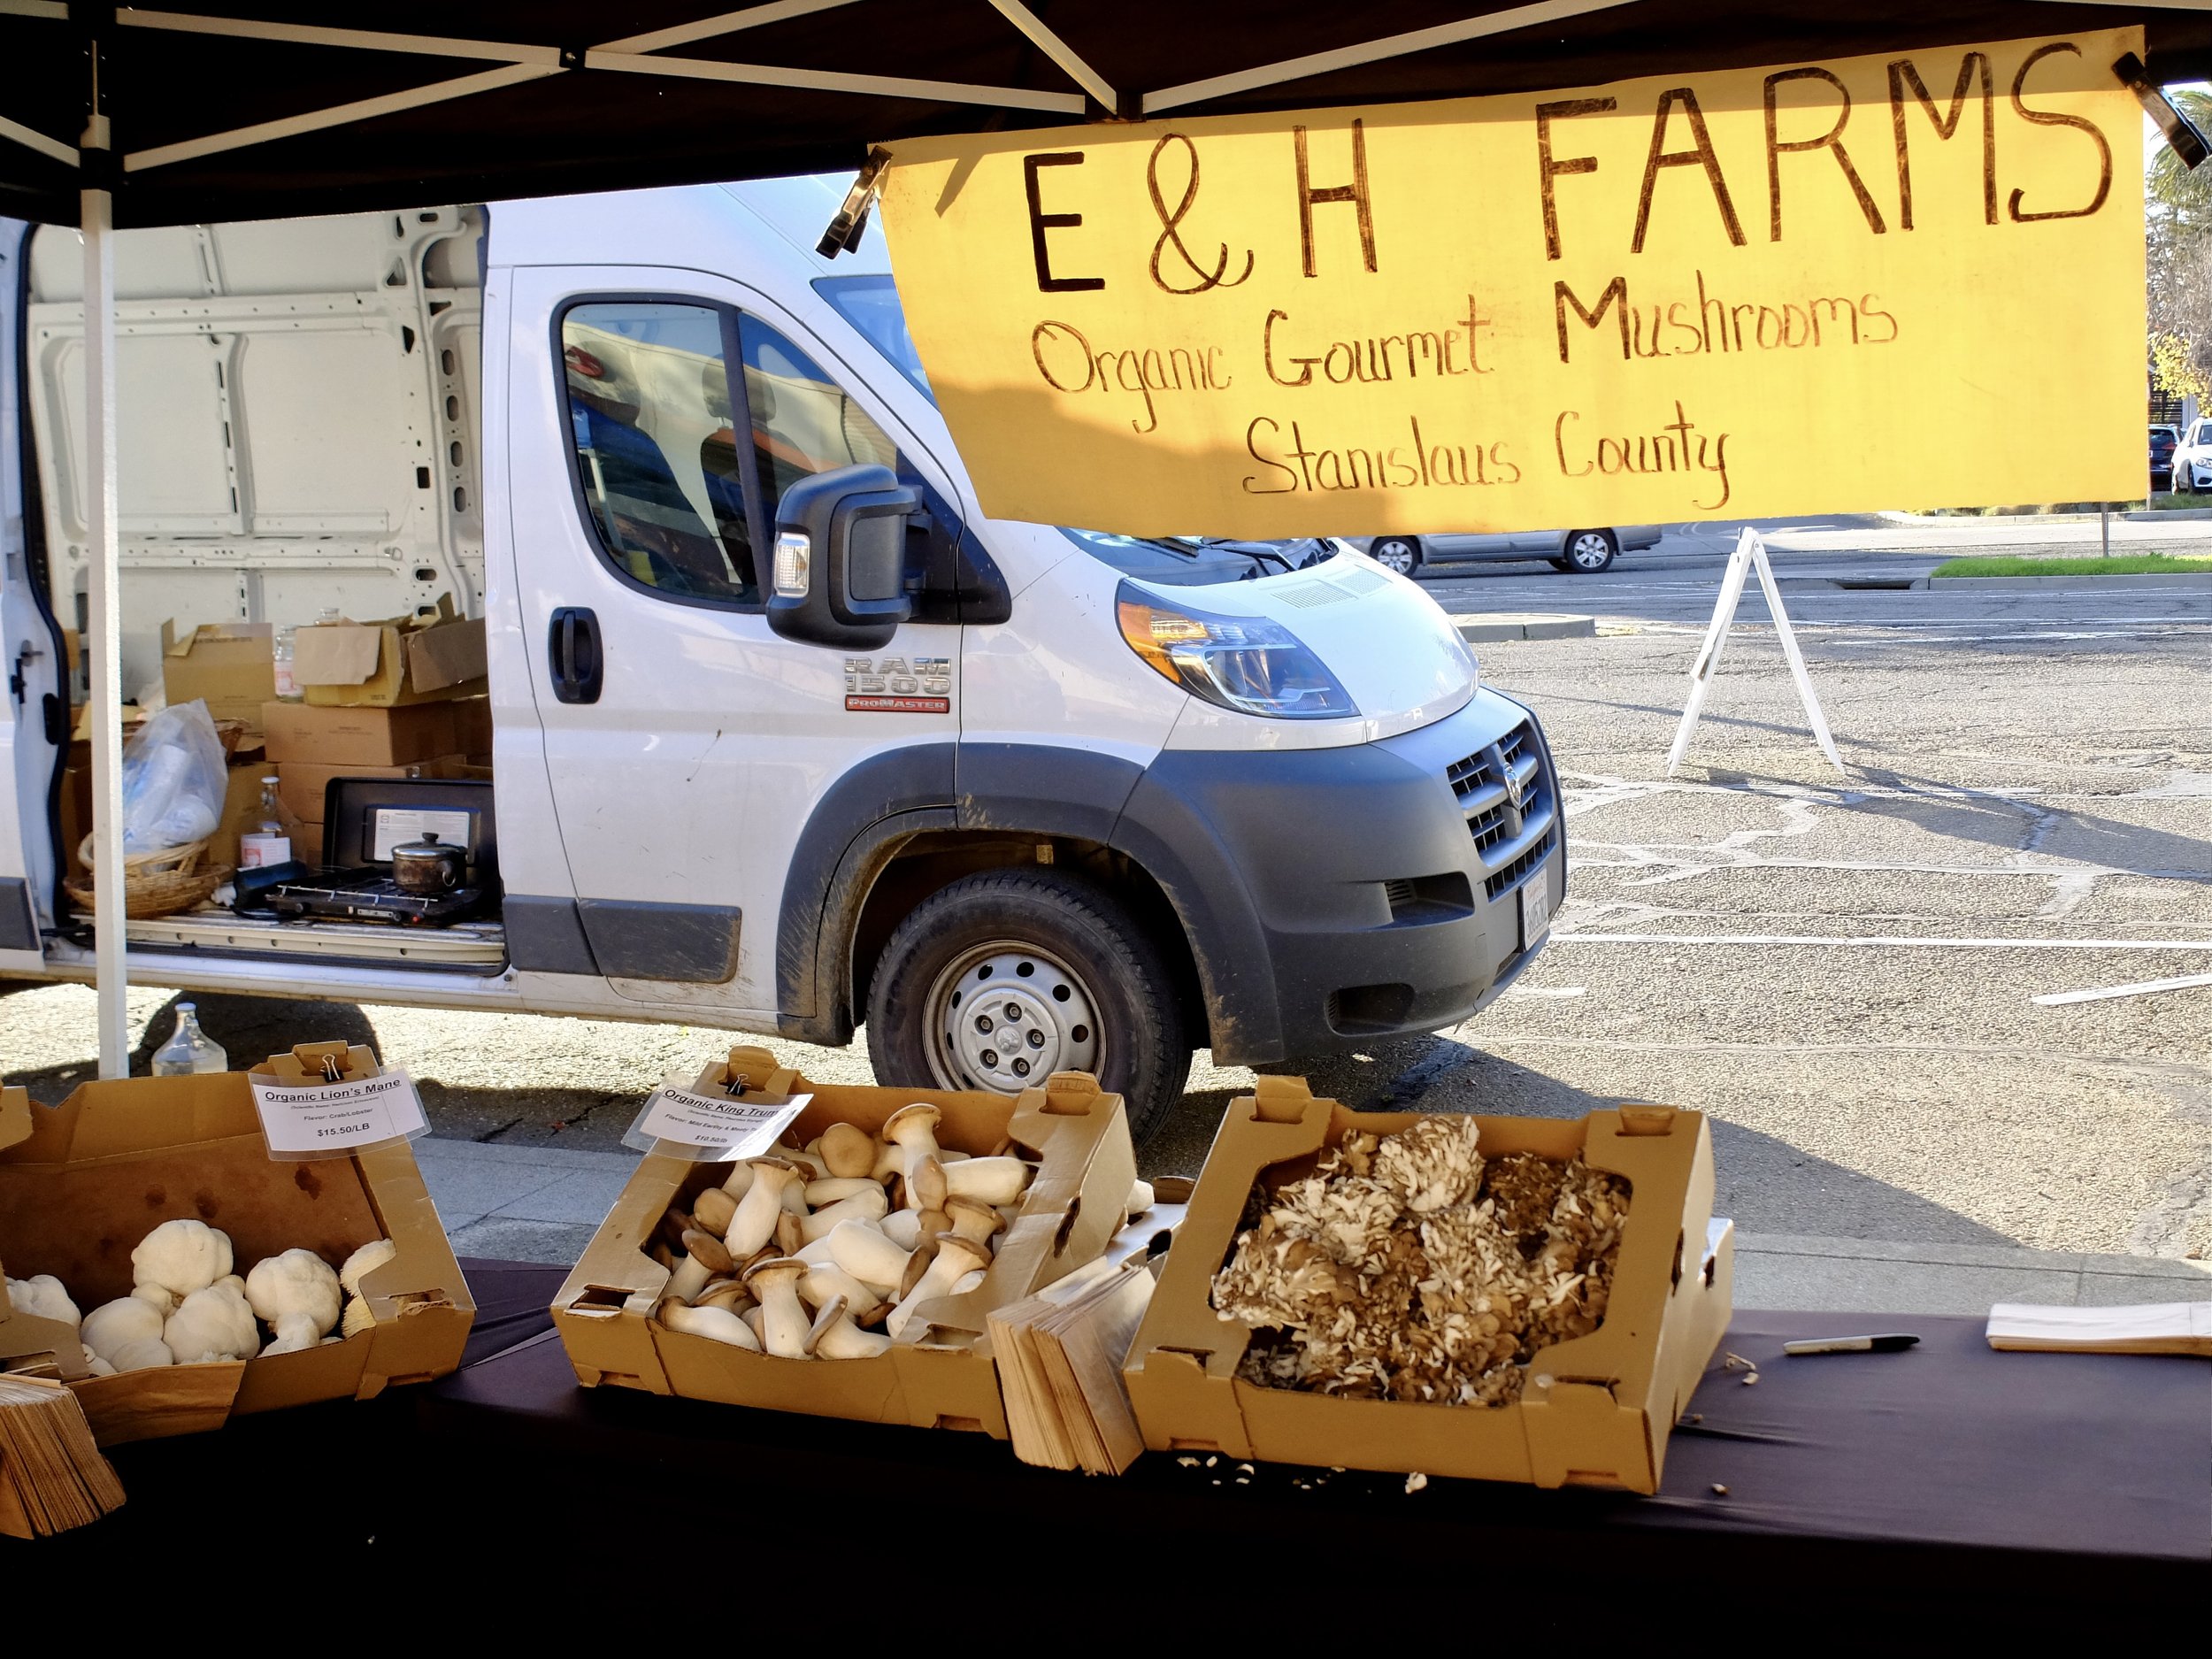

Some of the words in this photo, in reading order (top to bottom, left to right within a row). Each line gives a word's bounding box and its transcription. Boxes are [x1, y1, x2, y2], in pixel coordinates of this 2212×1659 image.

[1024, 150, 1105, 293] E
[1147, 133, 1255, 295] &
[1293, 118, 1379, 278] H
[1535, 42, 2114, 261] FARMS
[1032, 319, 1233, 434] Organic
[1263, 294, 1496, 388] Gourmet
[1554, 270, 1899, 364] Mushrooms
[1242, 415, 1522, 495] Stanislaus
[1555, 399, 1730, 510] County
[845, 657, 951, 675] RAM
[845, 675, 951, 695] 1500
[265, 1089, 317, 1102] Organic
[320, 1087, 361, 1101] Lion's
[365, 1079, 402, 1094] Mane
[664, 1089, 713, 1110] Organic
[715, 1103, 744, 1116] King
[318, 1123, 370, 1137] $15.50/LB
